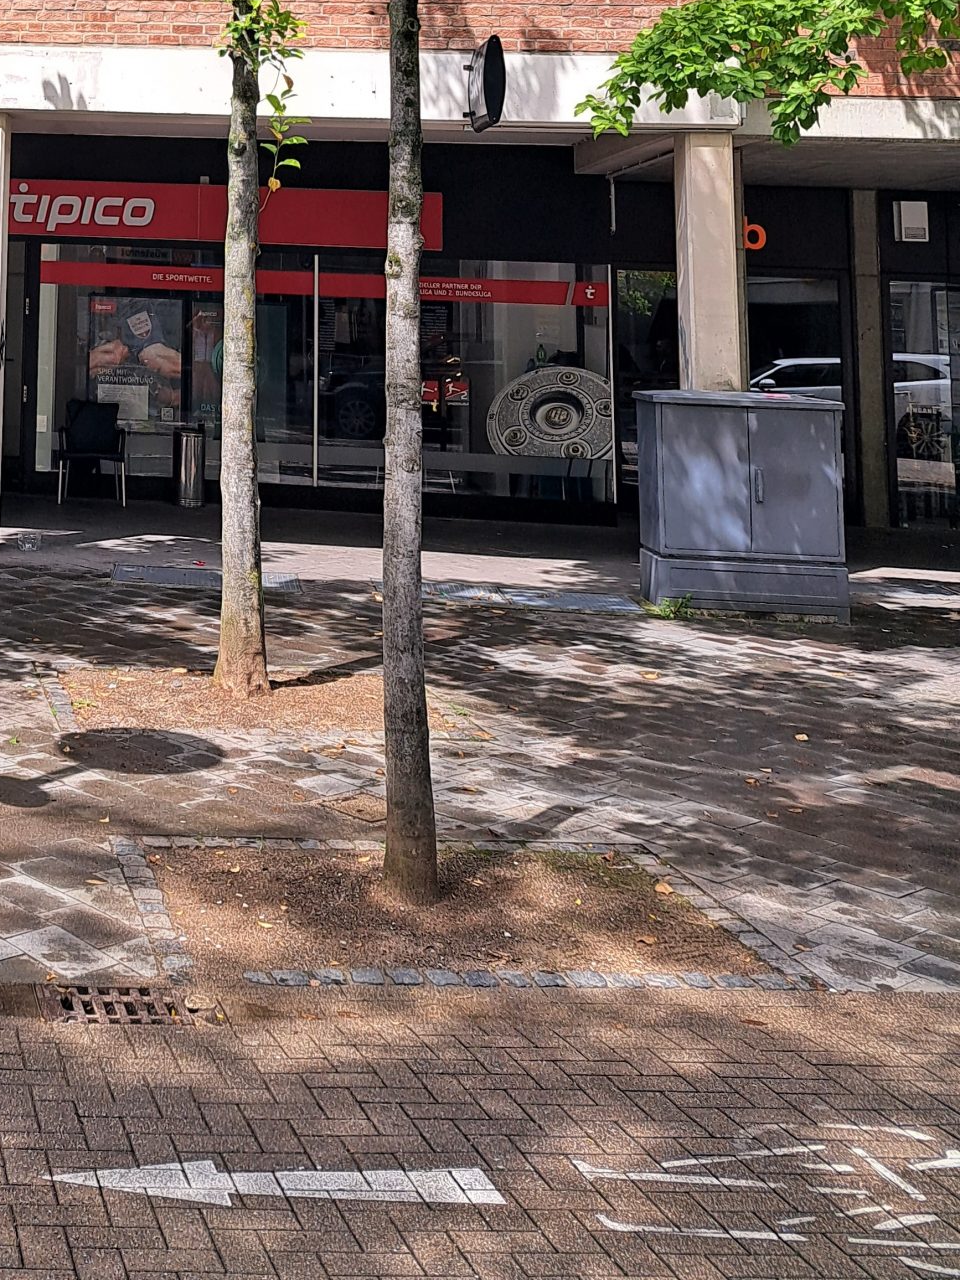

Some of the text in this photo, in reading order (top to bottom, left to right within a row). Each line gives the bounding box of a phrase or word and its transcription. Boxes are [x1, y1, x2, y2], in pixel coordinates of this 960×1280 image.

[10, 182, 155, 231] tipico
[152, 273, 213, 283] DIE SPORTWETTE.
[442, 282, 469, 290] PARTNER
[455, 290, 492, 298] BUNDESLIGA
[97, 367, 128, 376] SPIEL MIT
[97, 375, 154, 384] VERANTWORTUNG
